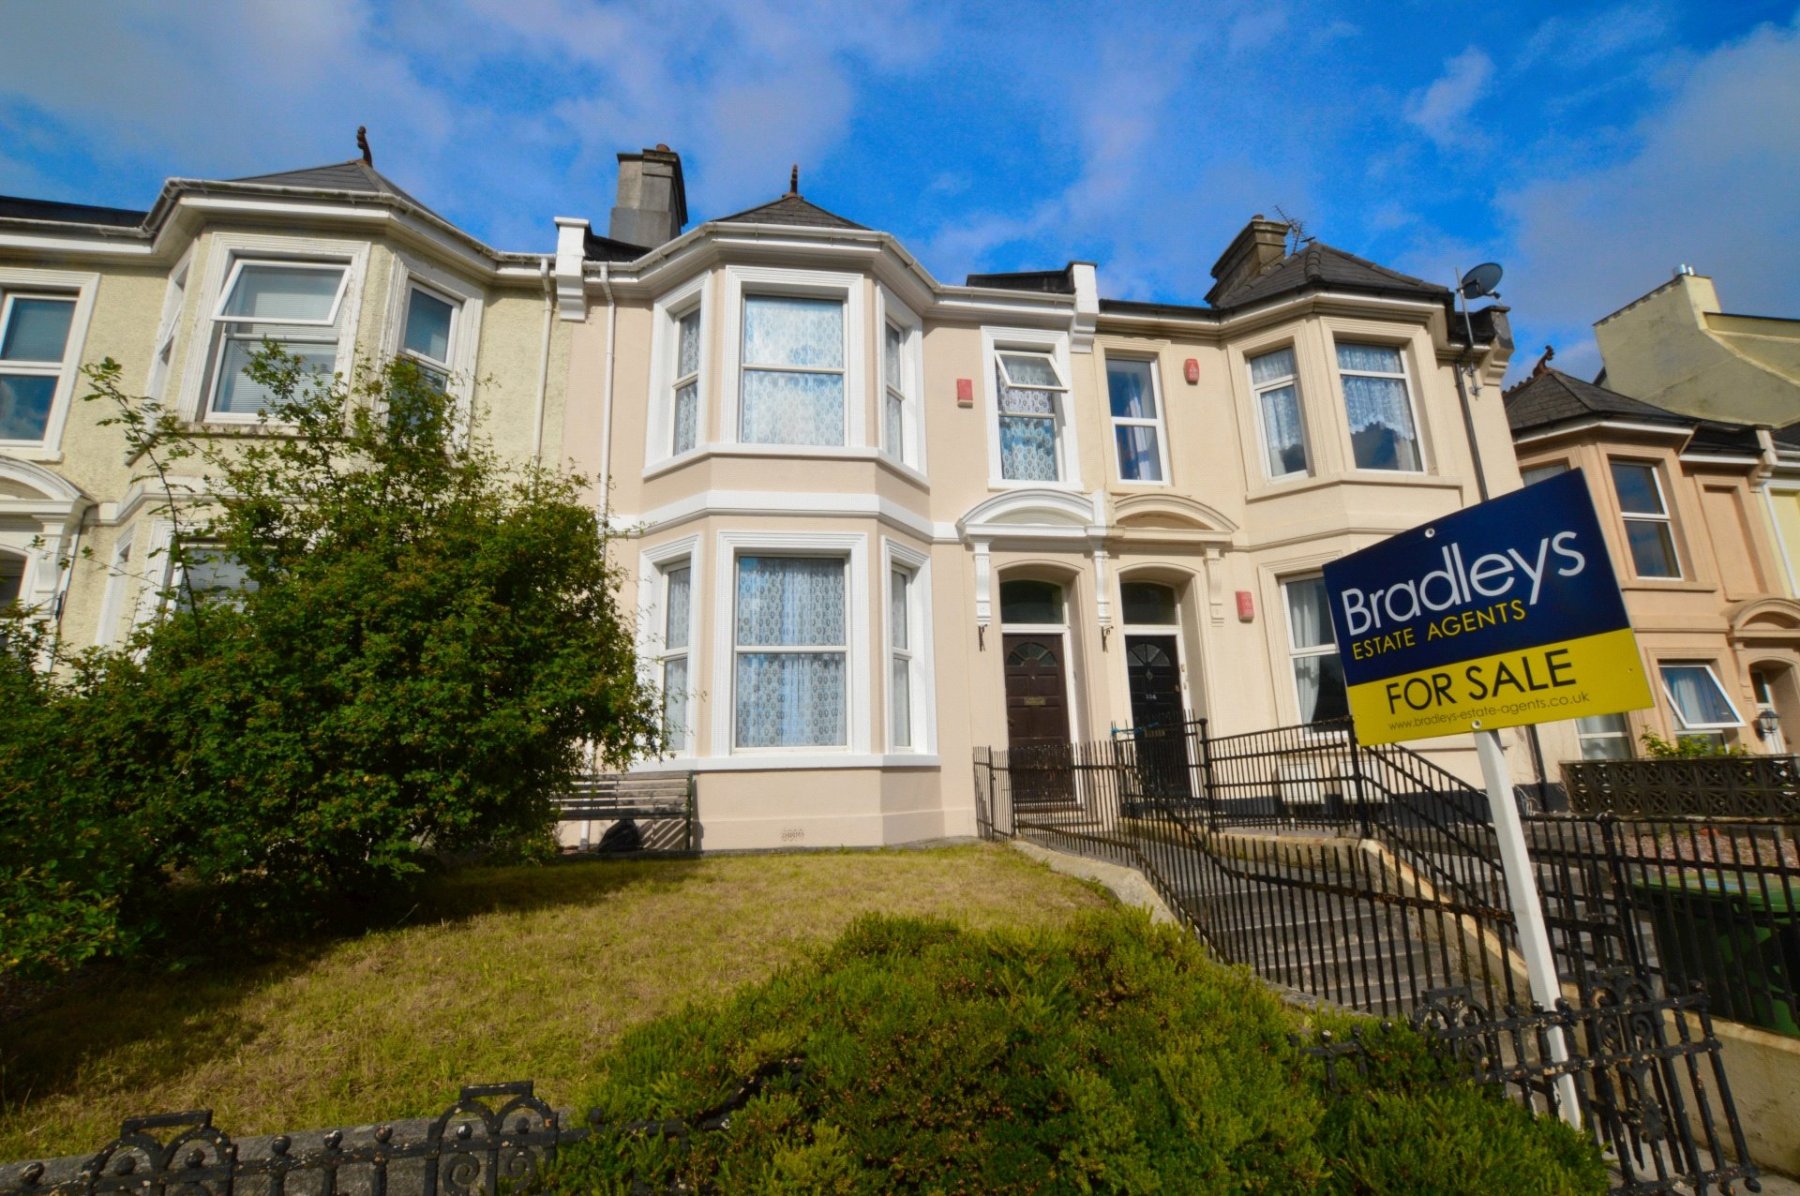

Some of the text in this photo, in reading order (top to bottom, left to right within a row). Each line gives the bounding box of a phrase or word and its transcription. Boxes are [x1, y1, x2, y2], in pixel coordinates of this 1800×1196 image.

[1341, 531, 1586, 637] Bradleys
[1352, 599, 1527, 660] ESTATE AGENTS
[1386, 648, 1577, 715] FOR SALE
[1388, 691, 1590, 731] www.bradleys-estate-agents.co.uk
